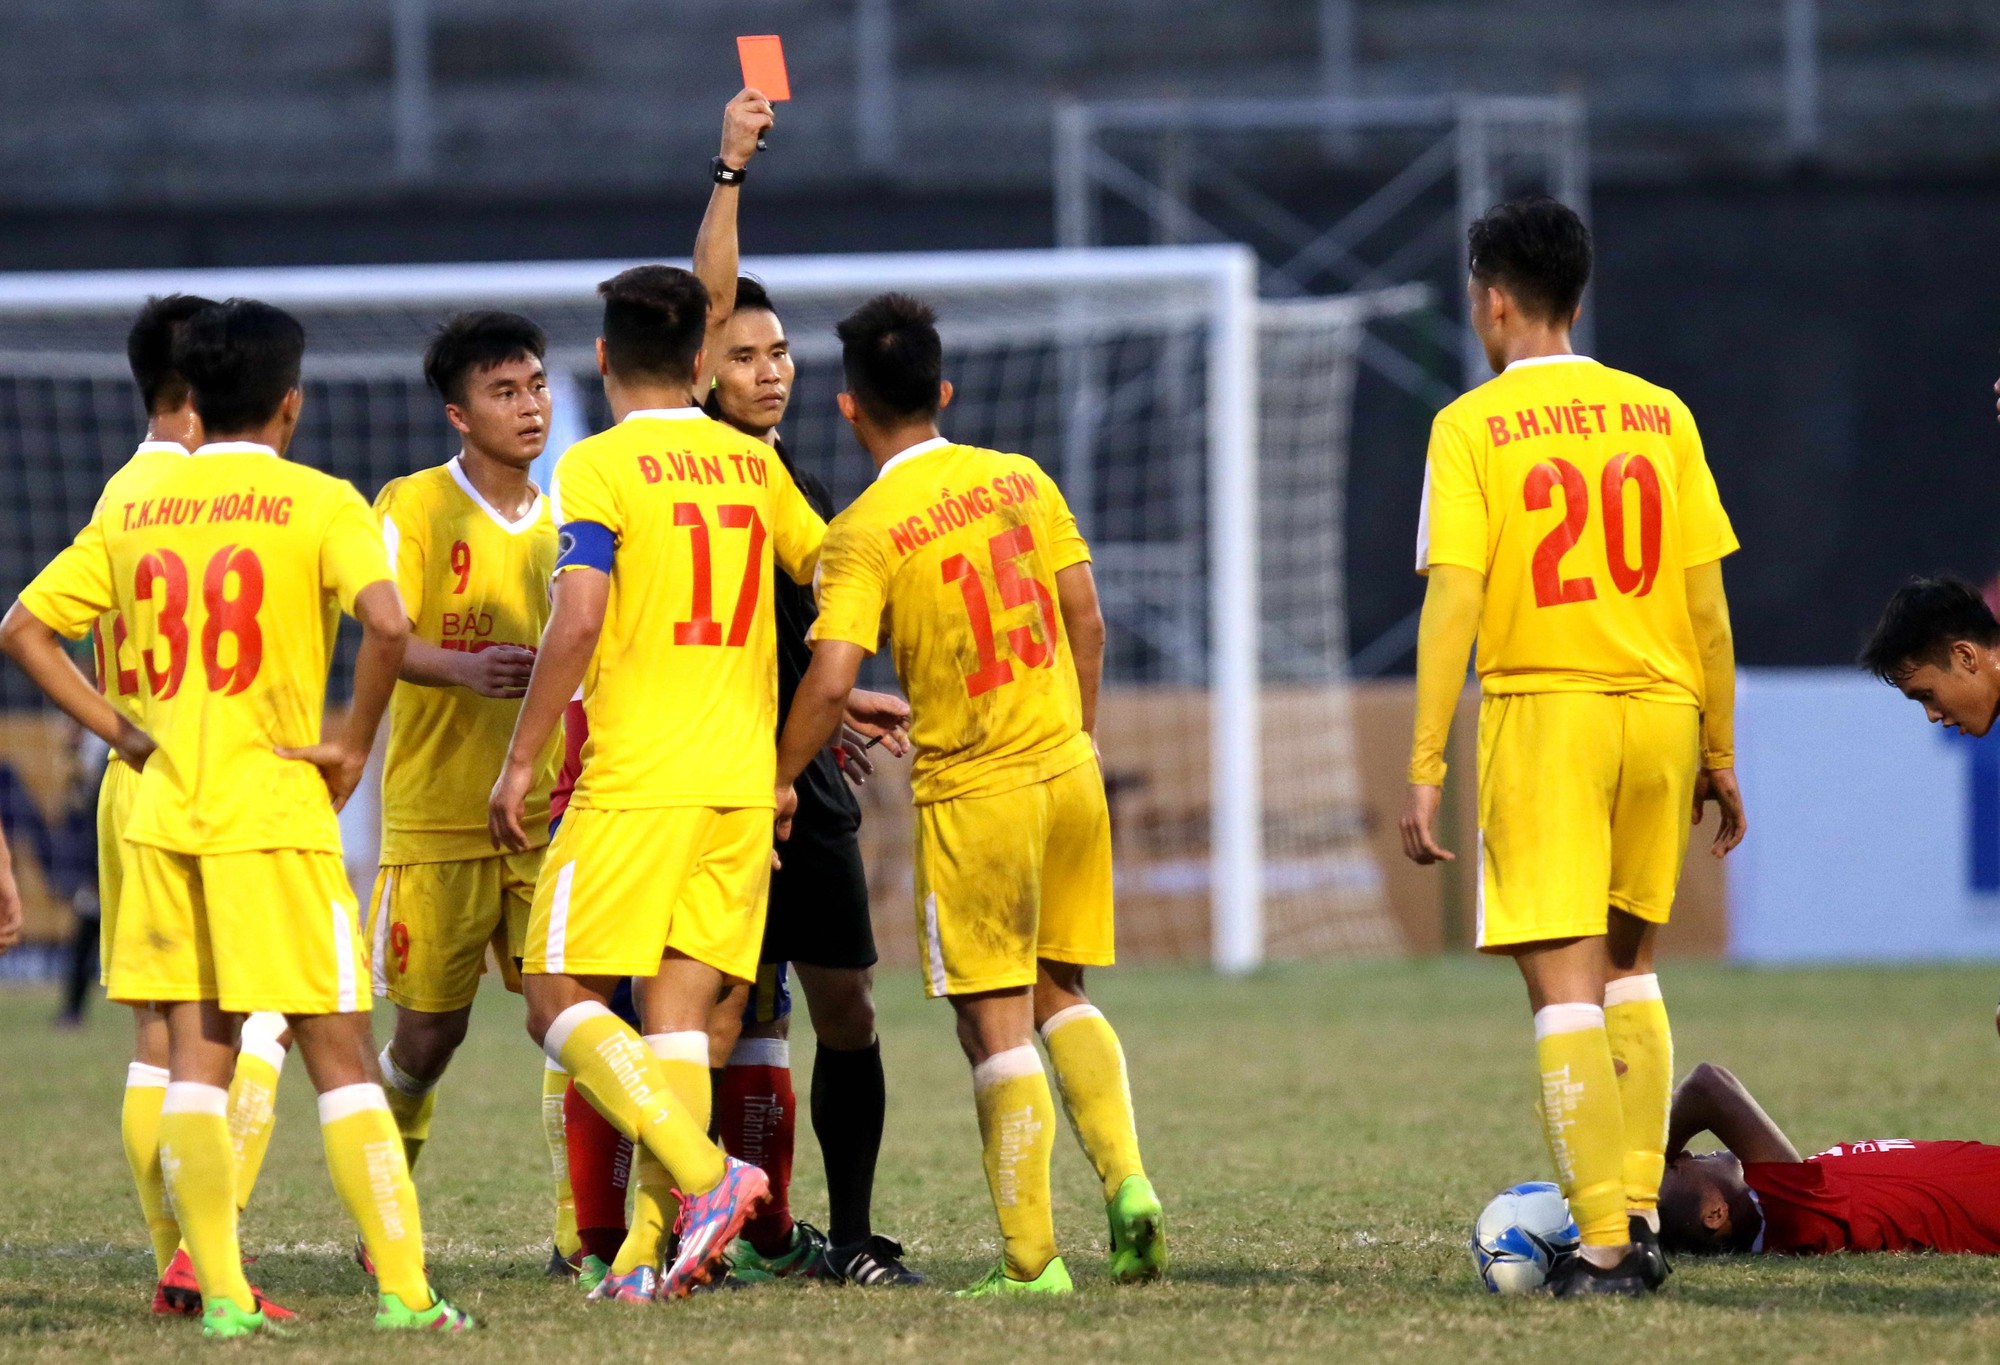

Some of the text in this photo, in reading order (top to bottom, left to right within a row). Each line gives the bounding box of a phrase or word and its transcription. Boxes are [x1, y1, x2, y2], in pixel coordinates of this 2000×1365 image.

[1486, 399, 1672, 447] B.H.VIỆT ANH
[637, 448, 768, 488] Đ.VĂN TỚI
[123, 486, 293, 532] T.K.HUY HOÀNG
[888, 471, 1039, 556] NG.HỒNG SƠN
[1523, 452, 1663, 608] 20
[450, 539, 471, 595] 9
[673, 502, 767, 647] 17
[134, 543, 264, 701] 38
[442, 606, 494, 637] BÁO
[940, 524, 1058, 699] 15
[390, 922, 410, 974] 9
[596, 1030, 648, 1095] Thanh
